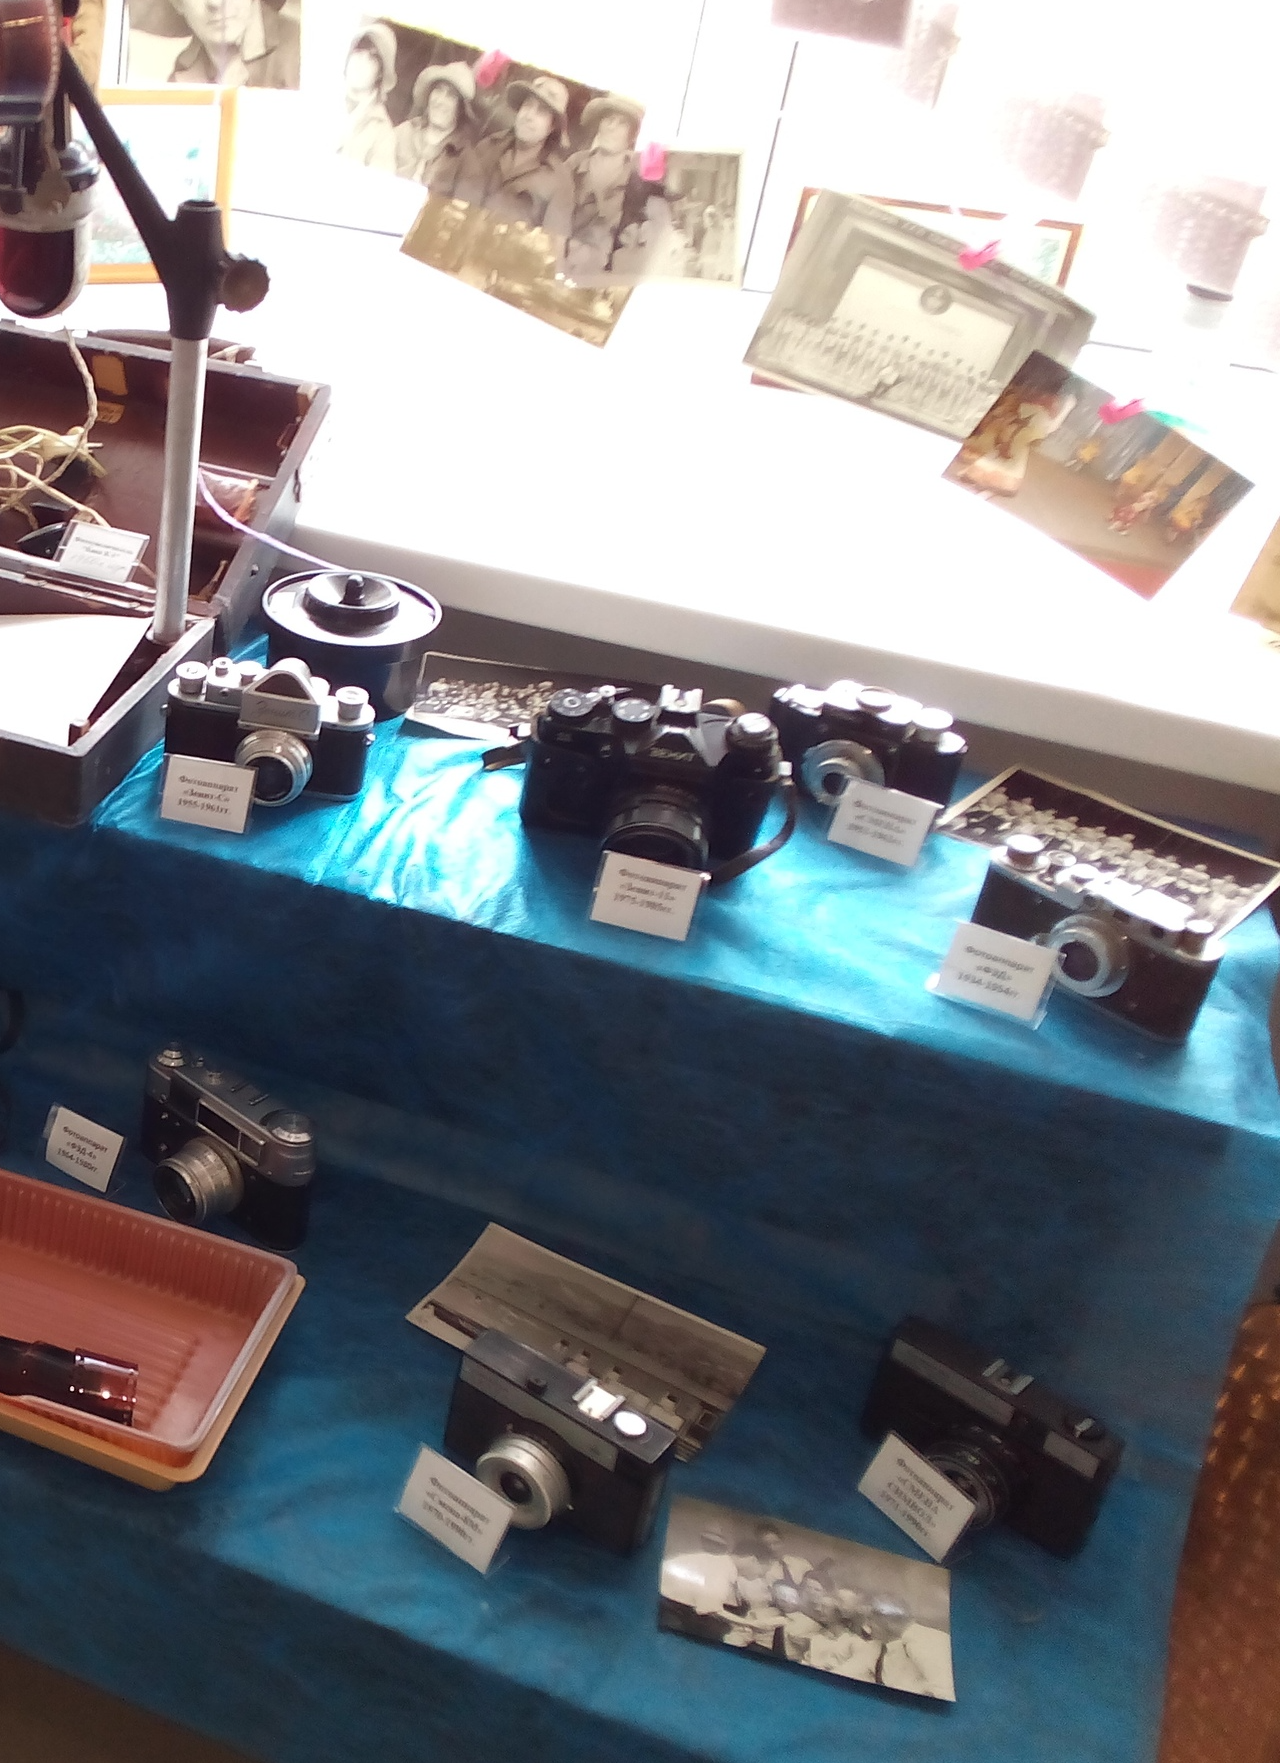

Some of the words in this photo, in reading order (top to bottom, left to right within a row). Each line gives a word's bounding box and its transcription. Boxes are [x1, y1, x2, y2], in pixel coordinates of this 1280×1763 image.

[178, 774, 239, 793] Фотоаппарат
[183, 788, 230, 803] «Зенит-С»
[618, 867, 688, 891] Фотоаппарат
[964, 944, 1035, 974] Фотоаппарат
[976, 964, 1013, 981] «ФЭД»
[62, 1125, 108, 1153] Фотоаппарат
[66, 1140, 97, 1160] «ФЭД-4»
[896, 1457, 955, 1512] Фотоаппарат
[429, 1475, 491, 1525] Фотоаппарат
